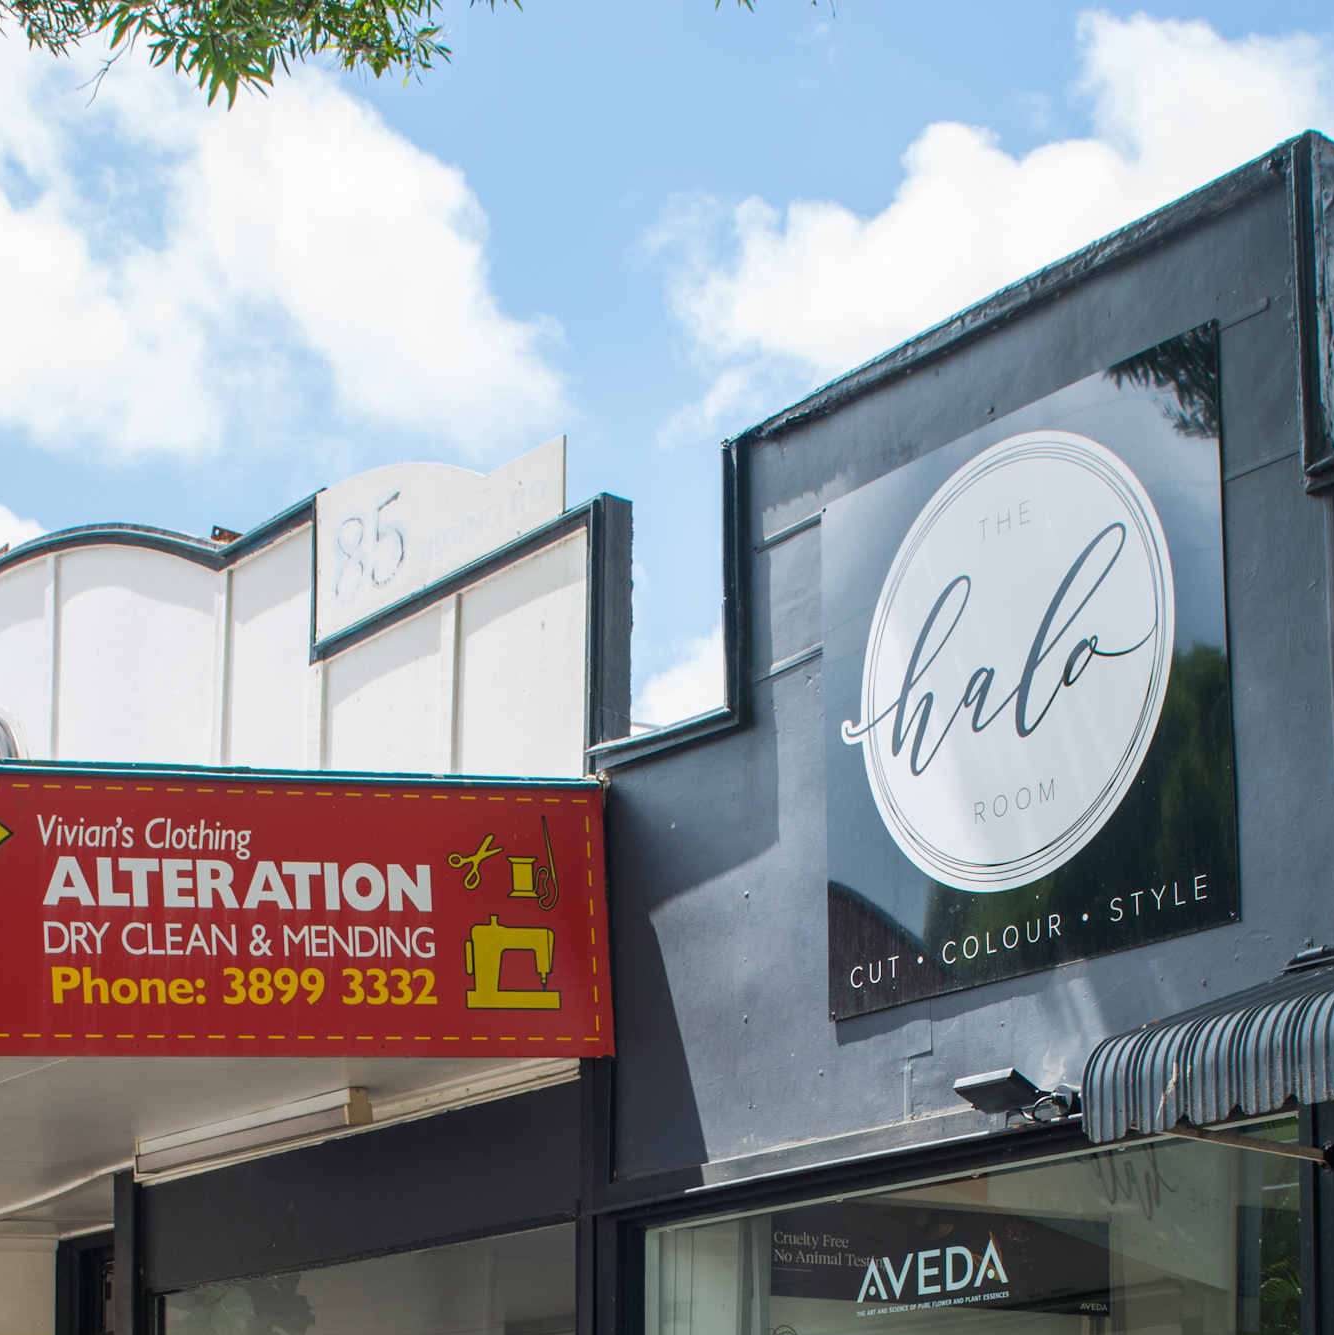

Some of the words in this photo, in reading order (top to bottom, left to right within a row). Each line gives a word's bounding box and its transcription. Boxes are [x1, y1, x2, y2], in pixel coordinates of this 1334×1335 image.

[978, 500, 1031, 541] THE
[334, 488, 405, 602] 85
[844, 521, 1158, 776] halo
[974, 778, 1057, 825] ROOM
[37, 814, 135, 850] Vivian's
[144, 819, 252, 860] Clothing
[42, 856, 433, 912] ALTERATION
[42, 921, 111, 956] DRY
[121, 923, 240, 957] CLEAN
[249, 926, 273, 956] &
[284, 926, 436, 960] MENDING
[849, 953, 902, 989] CUT
[942, 912, 1062, 965] COLOUR
[1109, 874, 1208, 922] STYLE
[51, 966, 206, 1006] Phone:
[223, 966, 325, 1006] 3899
[341, 968, 438, 1007] 3332
[773, 1231, 819, 1250] Cruelty
[823, 1234, 849, 1248] Free
[774, 1248, 792, 1262] No
[795, 1250, 842, 1266] Animal
[856, 1238, 1009, 1303] AVEDA
[888, 1304, 908, 1313] SCIENCE
[932, 1299, 952, 1308] FLOWER
[953, 1297, 964, 1305] AND
[965, 1295, 981, 1303] PLANT
[983, 1291, 1010, 1300] ESSENCES
[1080, 1302, 1108, 1312] AVEDA
